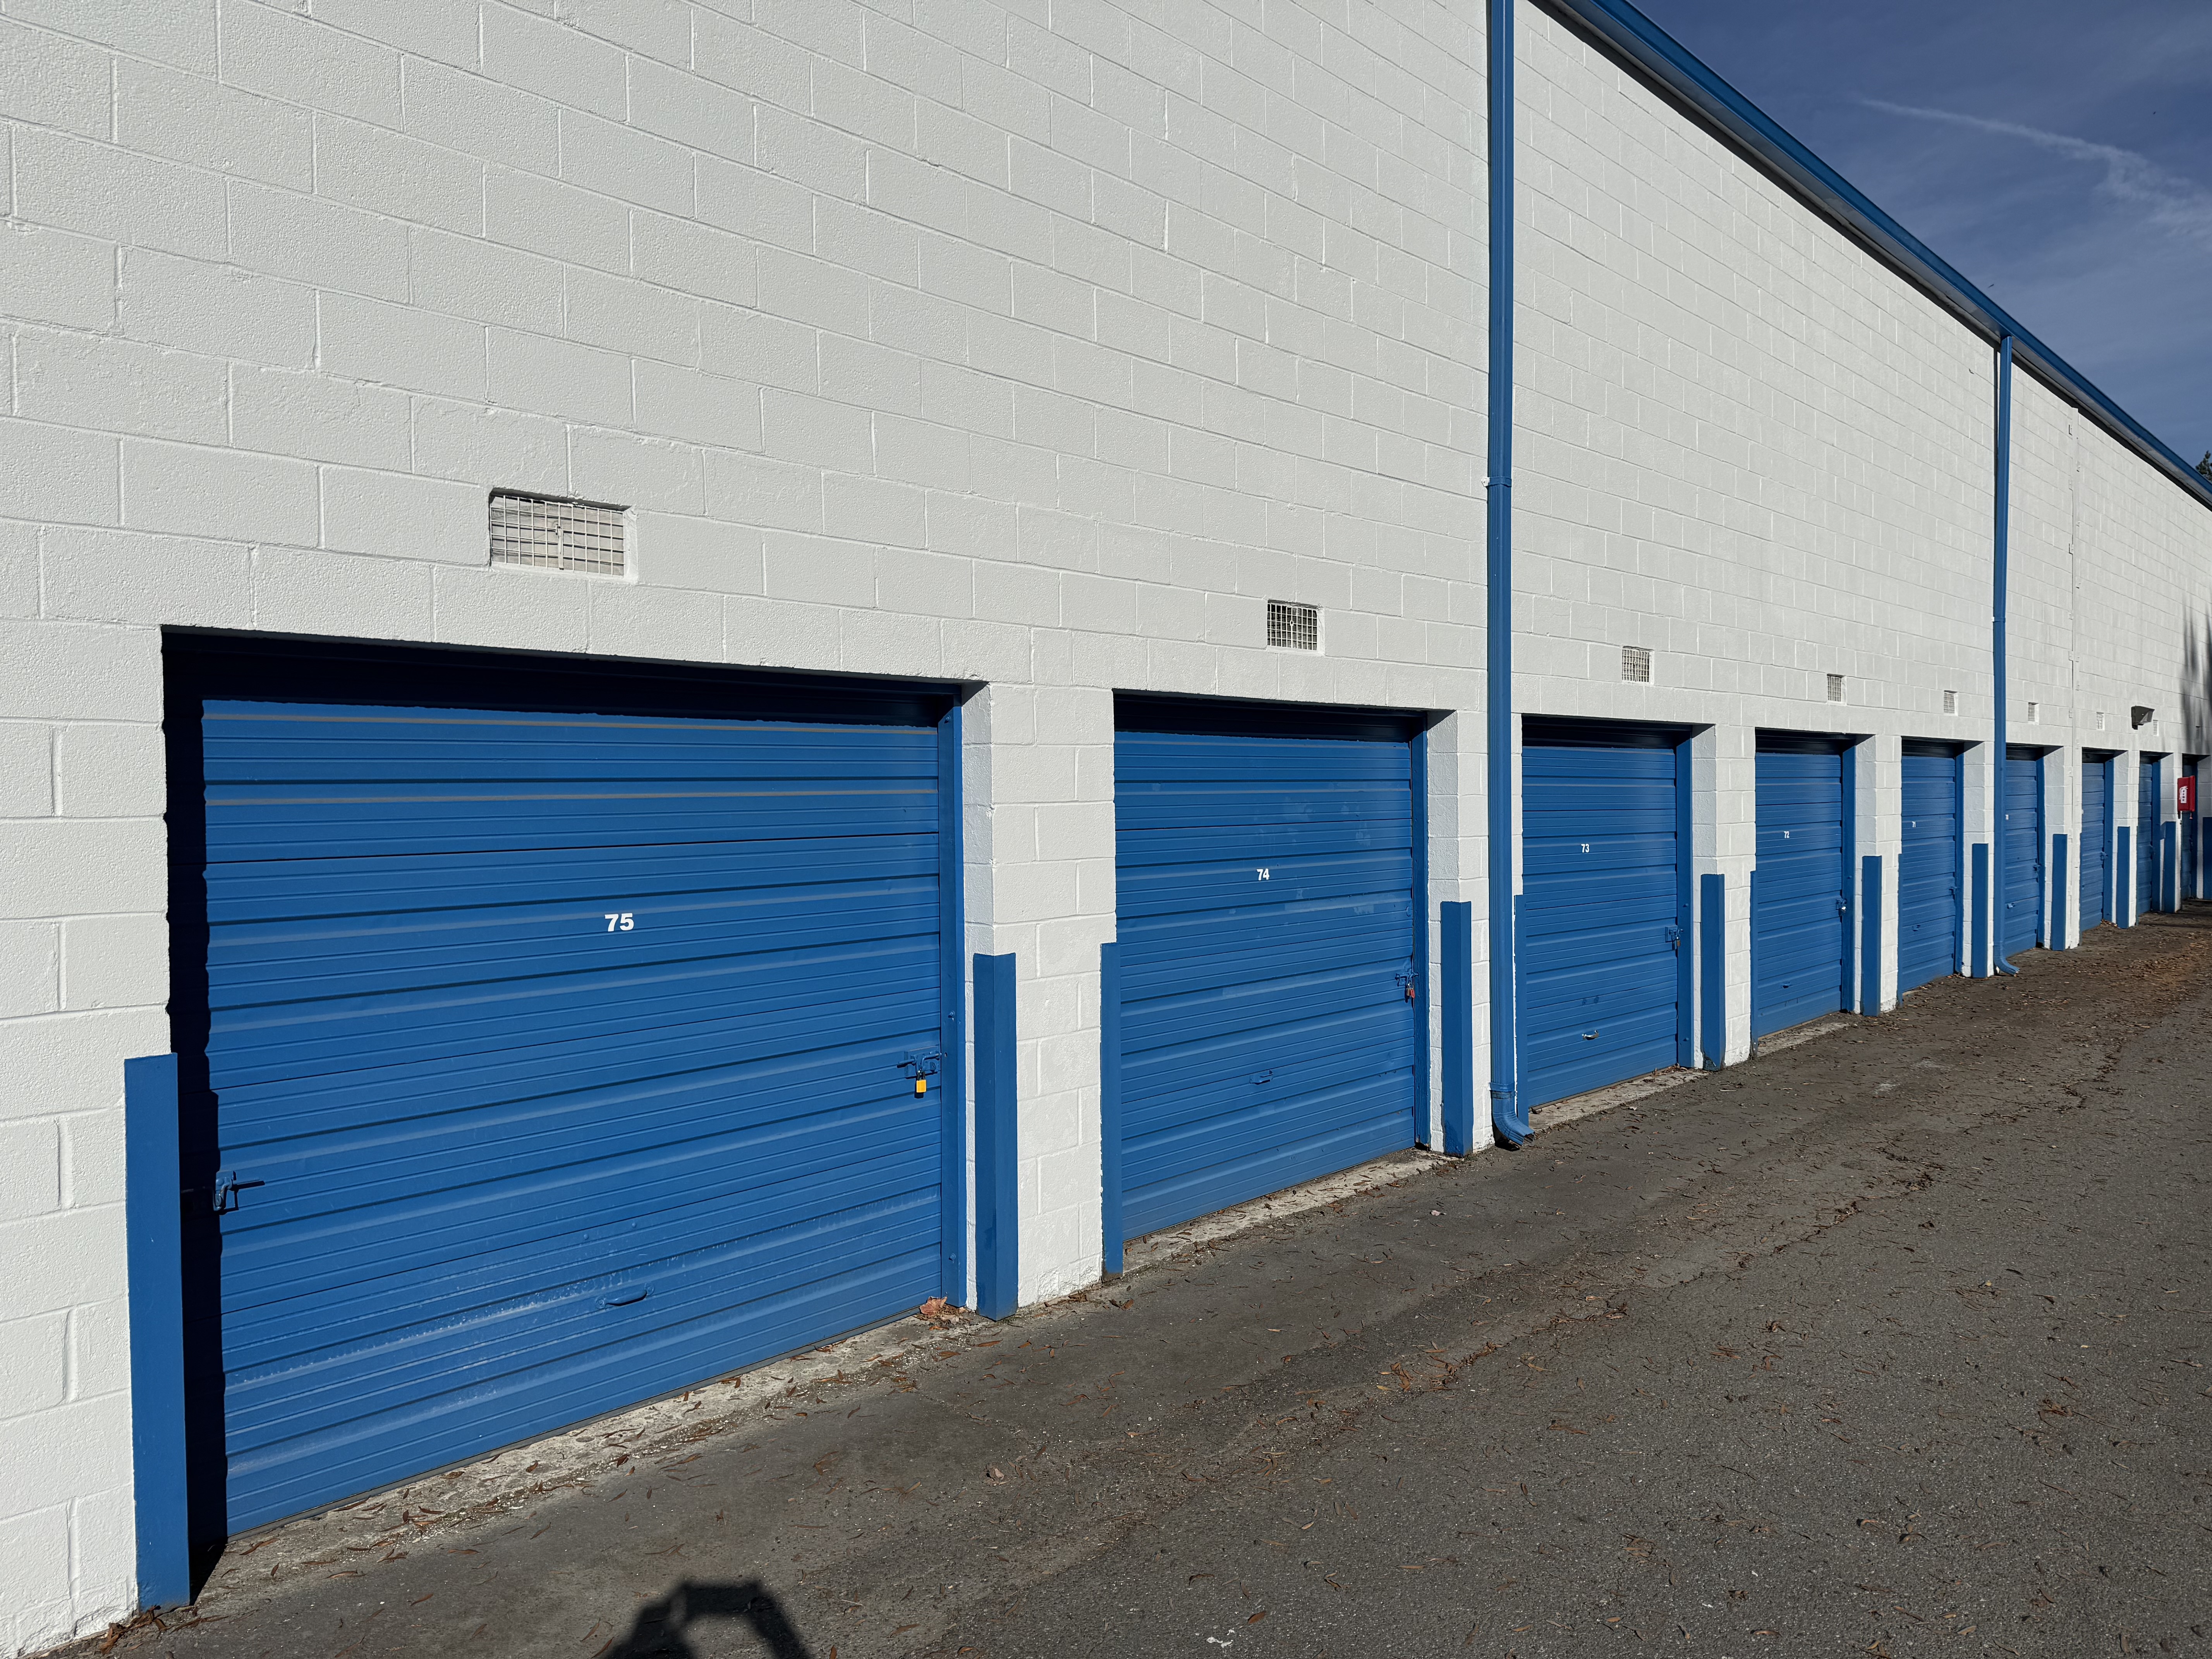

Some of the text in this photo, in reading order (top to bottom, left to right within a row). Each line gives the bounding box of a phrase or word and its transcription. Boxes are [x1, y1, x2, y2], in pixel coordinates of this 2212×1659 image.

[1581, 843, 1589, 853] 73
[1256, 868, 1270, 881] 74
[604, 913, 634, 932] 75
